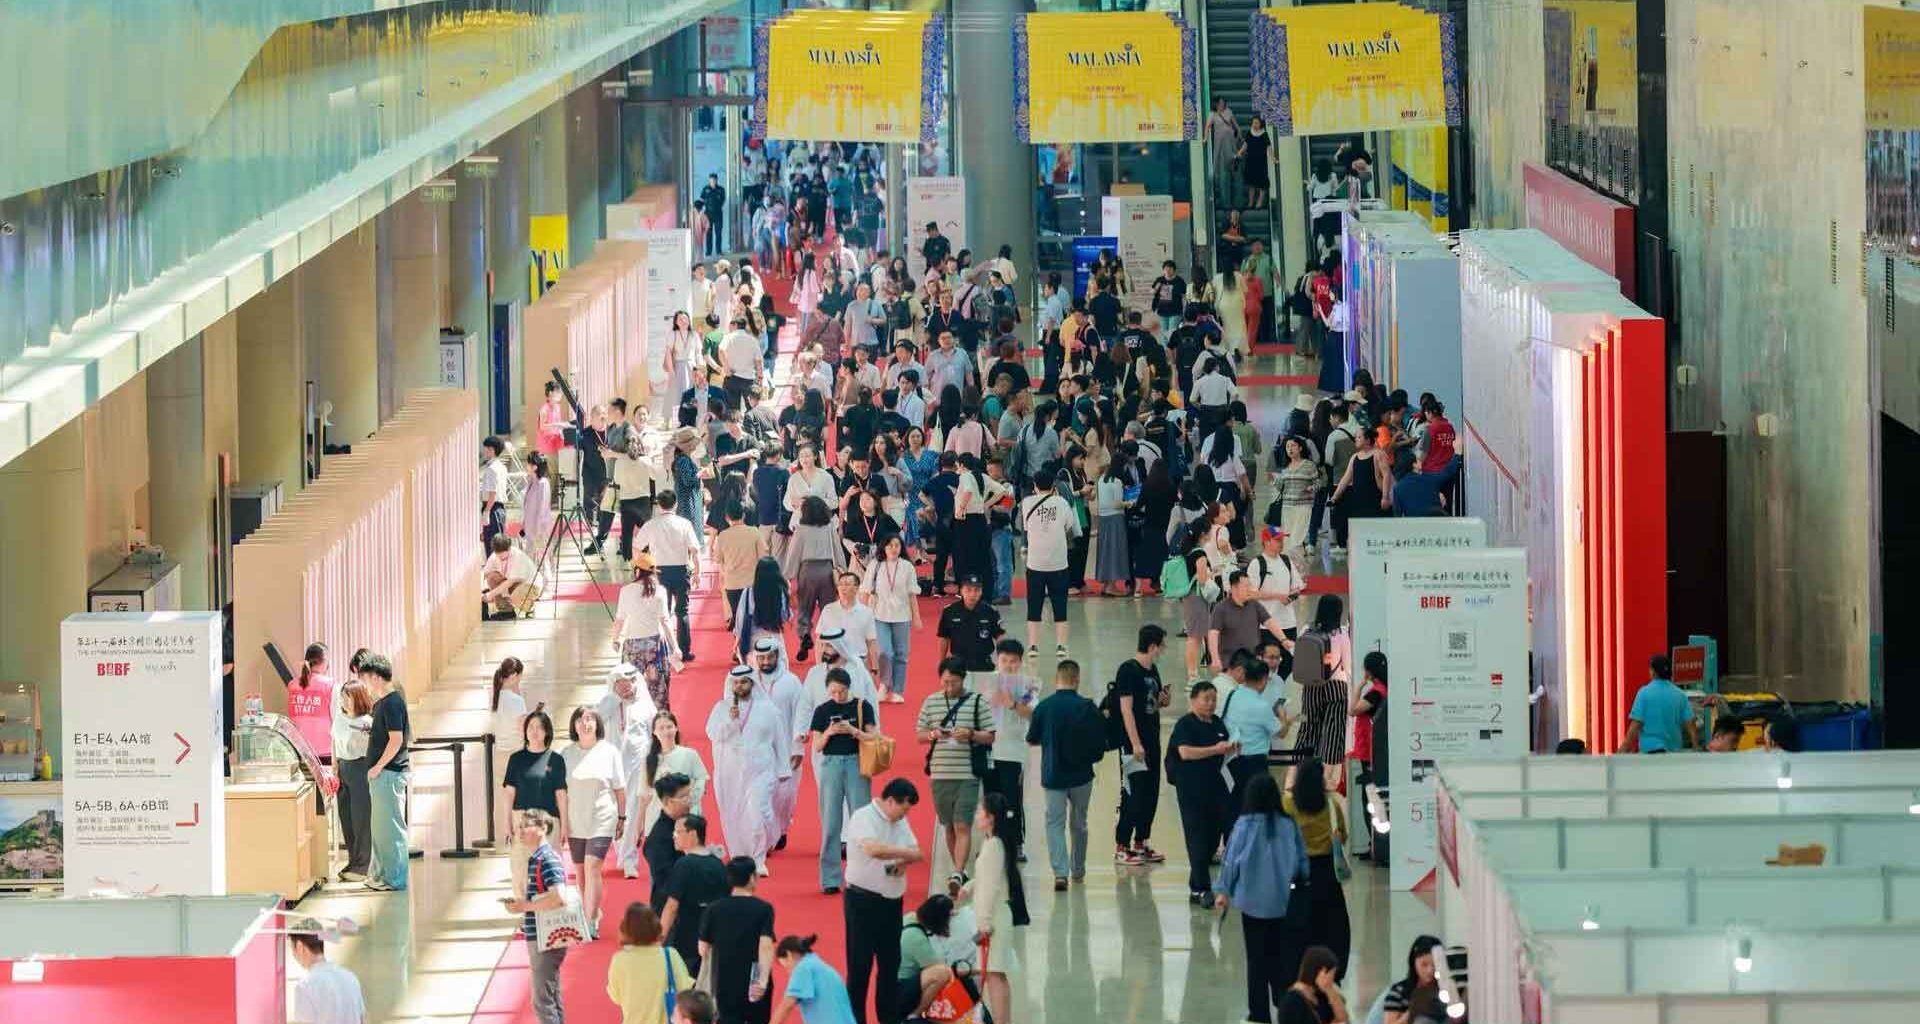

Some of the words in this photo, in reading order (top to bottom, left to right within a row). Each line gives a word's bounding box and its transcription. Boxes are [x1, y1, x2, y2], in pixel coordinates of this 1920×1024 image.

[1327, 40, 1401, 57] MALAYSIA
[808, 49, 881, 66] MALAYSIA
[1067, 50, 1142, 67] MALAYSIA
[1490, 703, 1503, 723] 2
[1410, 731, 1423, 752] 3
